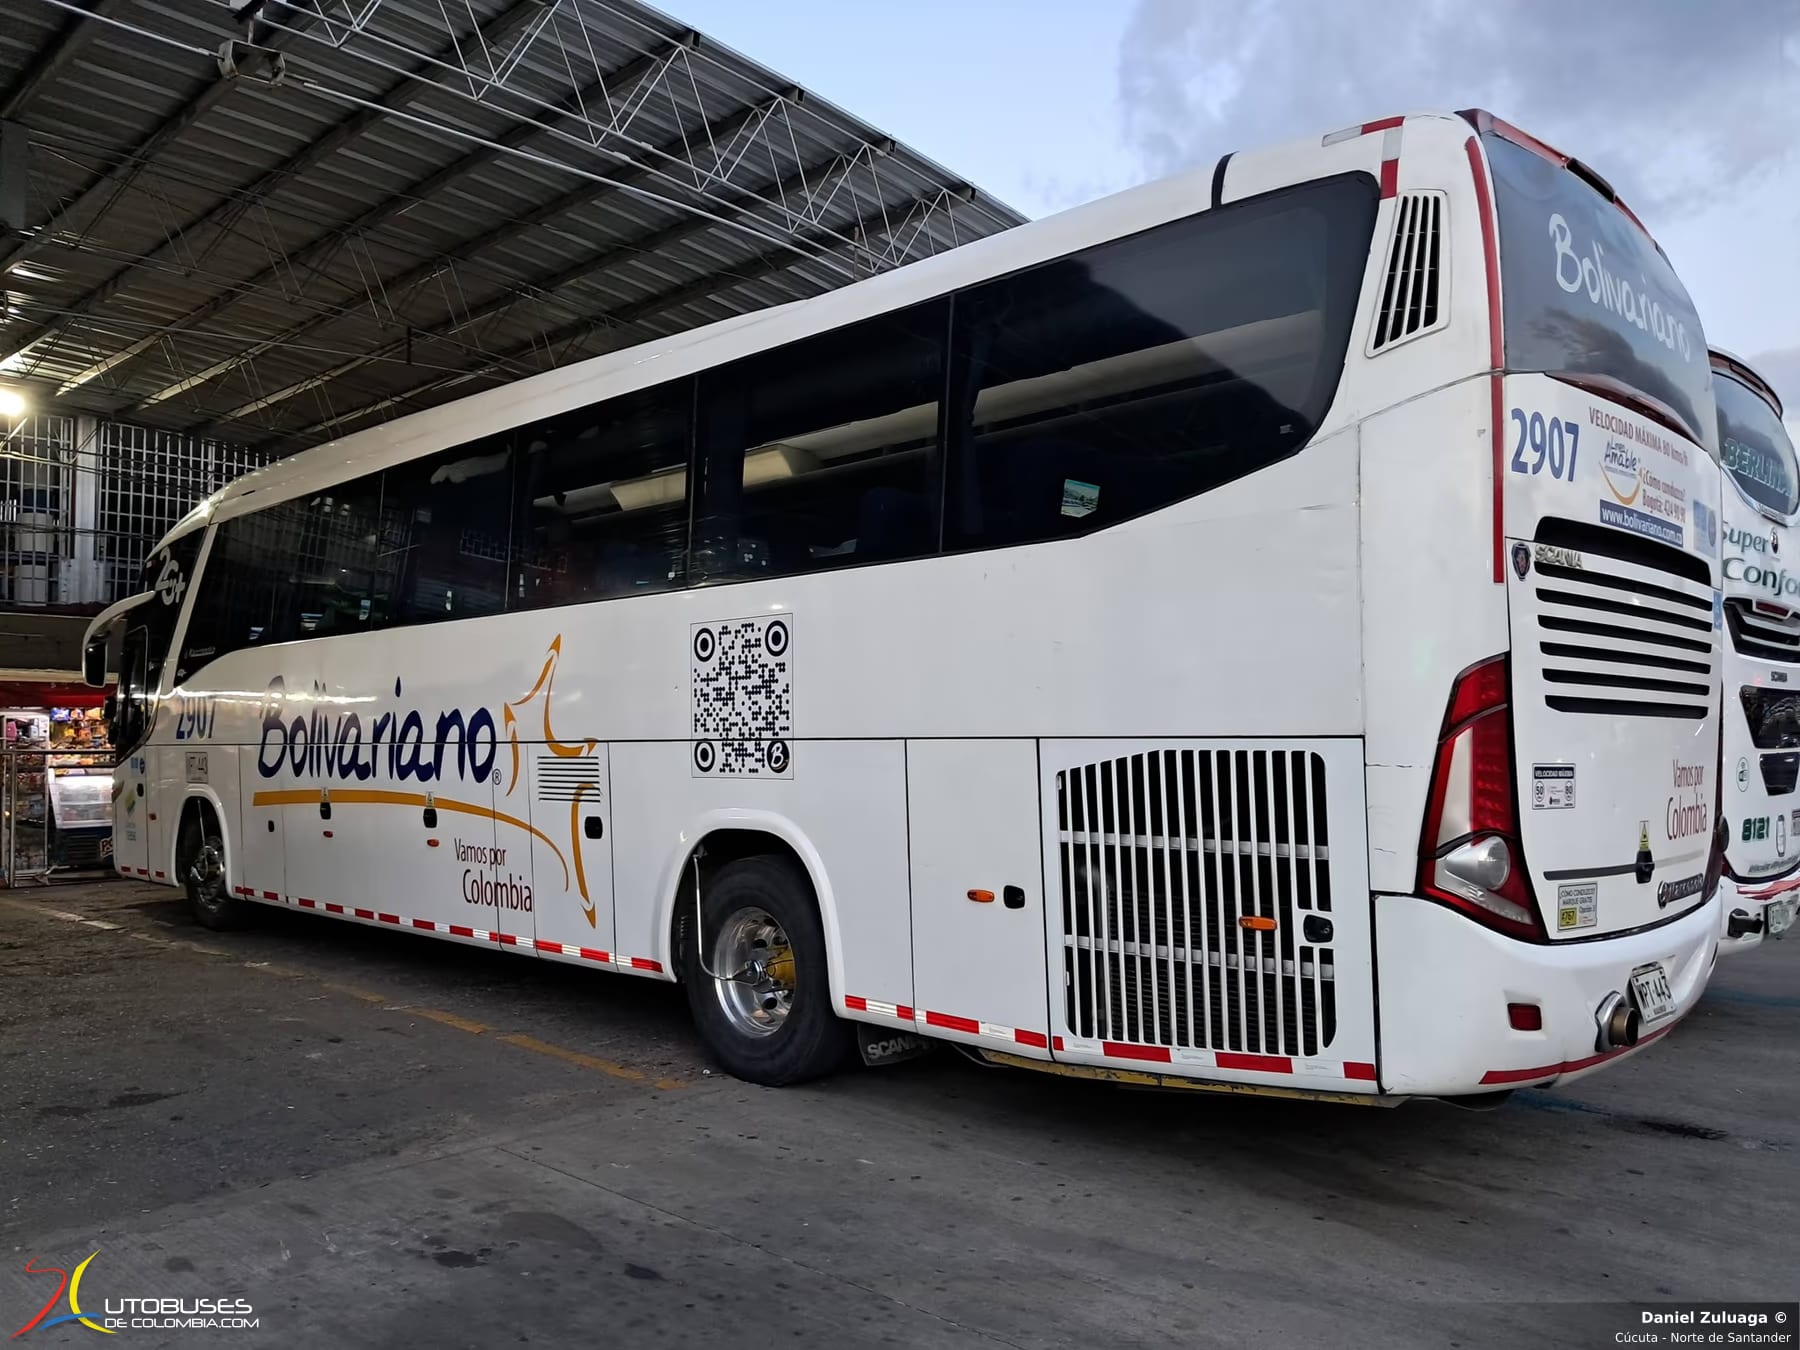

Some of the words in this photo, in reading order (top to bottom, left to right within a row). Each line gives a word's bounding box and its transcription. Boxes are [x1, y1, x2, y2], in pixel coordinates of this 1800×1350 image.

[1549, 213, 1690, 363] Bolivariano
[1589, 406, 1634, 440] VELOCIDAD
[1511, 408, 1579, 482] 2907
[1604, 441, 1638, 471] Amable
[1535, 544, 1583, 569] SCANIA
[1722, 557, 1800, 597] Confo
[175, 697, 217, 740] 2907
[258, 675, 498, 784] Bolivariano
[1672, 759, 1693, 788] Vamos
[1694, 765, 1704, 794] por
[1667, 793, 1707, 841] Colombia
[1742, 815, 1770, 841] 8121
[454, 837, 487, 864] Vamos
[489, 848, 506, 871] por
[463, 869, 533, 912] Colombia
